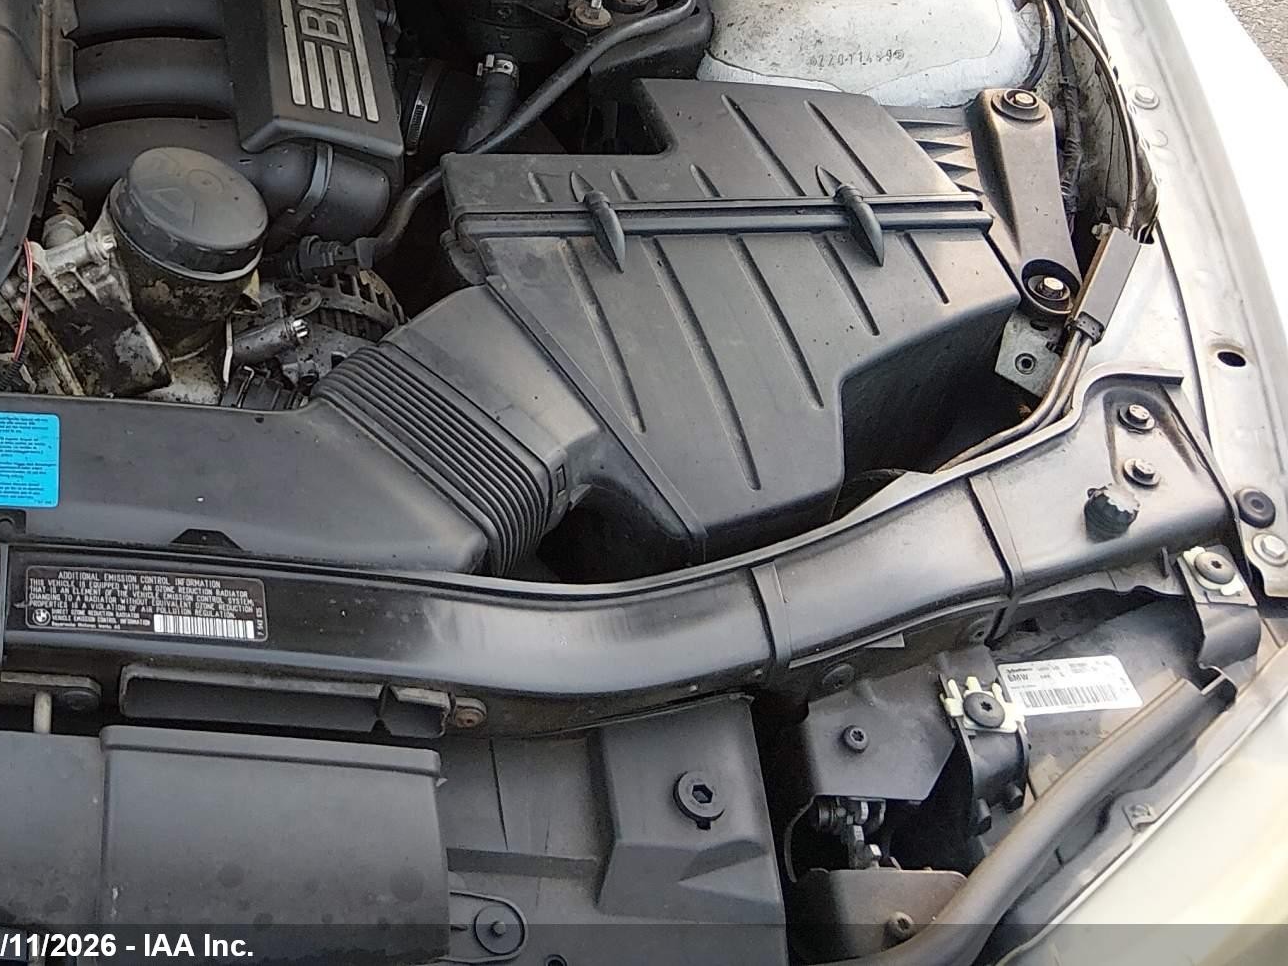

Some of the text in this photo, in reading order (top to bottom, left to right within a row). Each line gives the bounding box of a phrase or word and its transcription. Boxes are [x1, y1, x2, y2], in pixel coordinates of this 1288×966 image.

[30, 578, 44, 586] THIS
[48, 579, 74, 588] VEHICLE
[89, 581, 120, 590] EQUIPPED
[124, 583, 139, 591] WITH
[178, 587, 212, 595] REDUCTION
[216, 589, 248, 598] RADIATOR
[58, 571, 221, 588] ADDITIONAL EMISSION CONTROL INFORMATION
[29, 593, 60, 601] CHANGING
[65, 594, 72, 602] TO
[84, 595, 116, 603] RADIATOR
[152, 599, 191, 608] EQUIVALENT
[196, 601, 214, 610] OZONE
[219, 603, 253, 612] REDUCTION
[73, 587, 101, 595] ELEMENT
[117, 589, 128, 597] THE
[133, 591, 159, 599] VEHICLE
[163, 593, 193, 601] EMISSION
[197, 595, 225, 603] CONTROL
[29, 600, 68, 608] PROPERTIES
[91, 603, 126, 611] VIOLATION
[156, 606, 191, 615] POLLUTION
